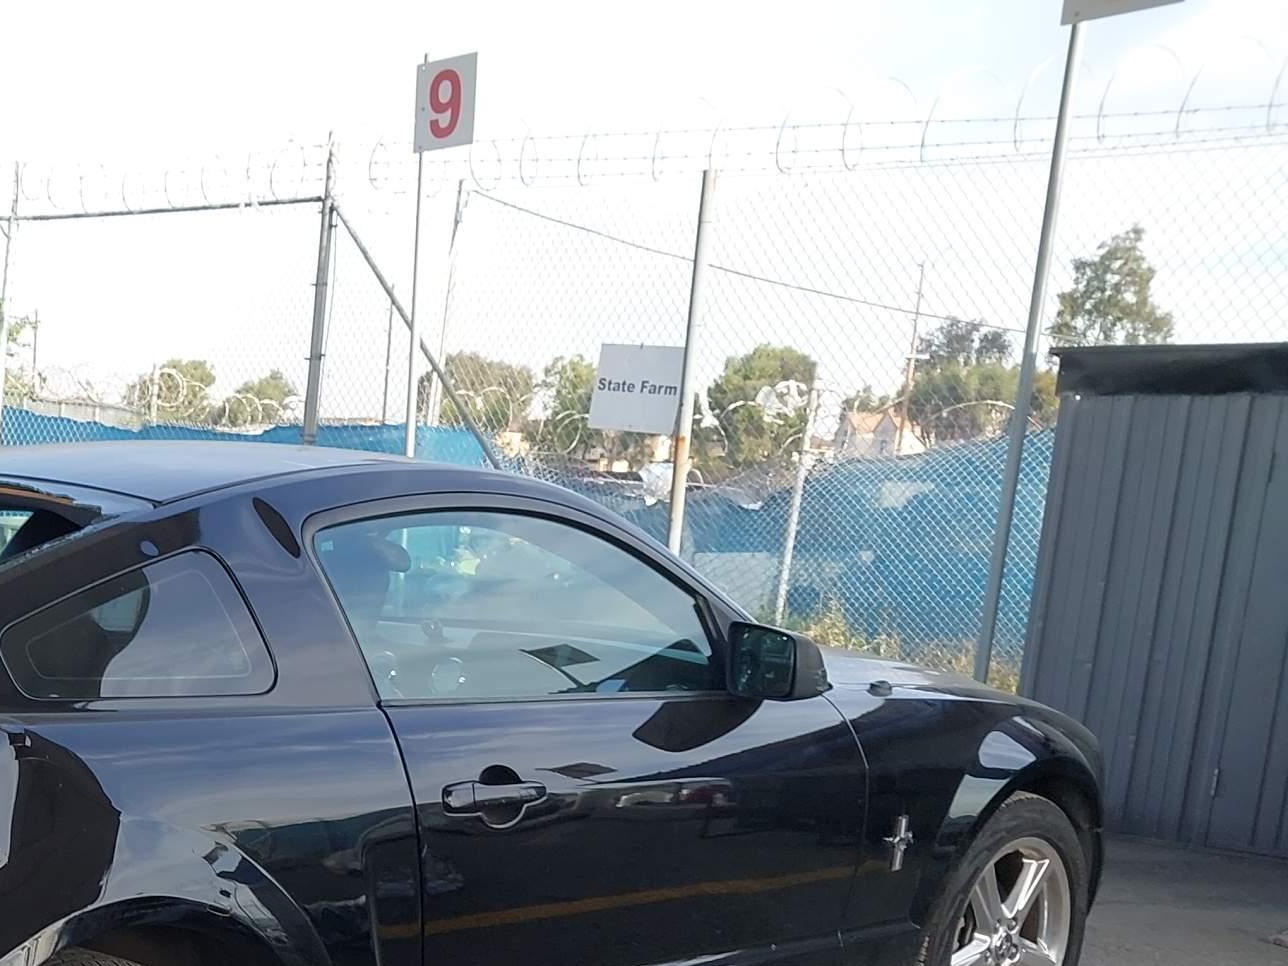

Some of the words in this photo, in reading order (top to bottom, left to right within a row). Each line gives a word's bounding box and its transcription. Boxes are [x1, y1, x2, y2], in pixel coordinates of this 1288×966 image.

[429, 68, 461, 139] 9
[598, 377, 635, 393] State
[640, 380, 678, 396] Farm
